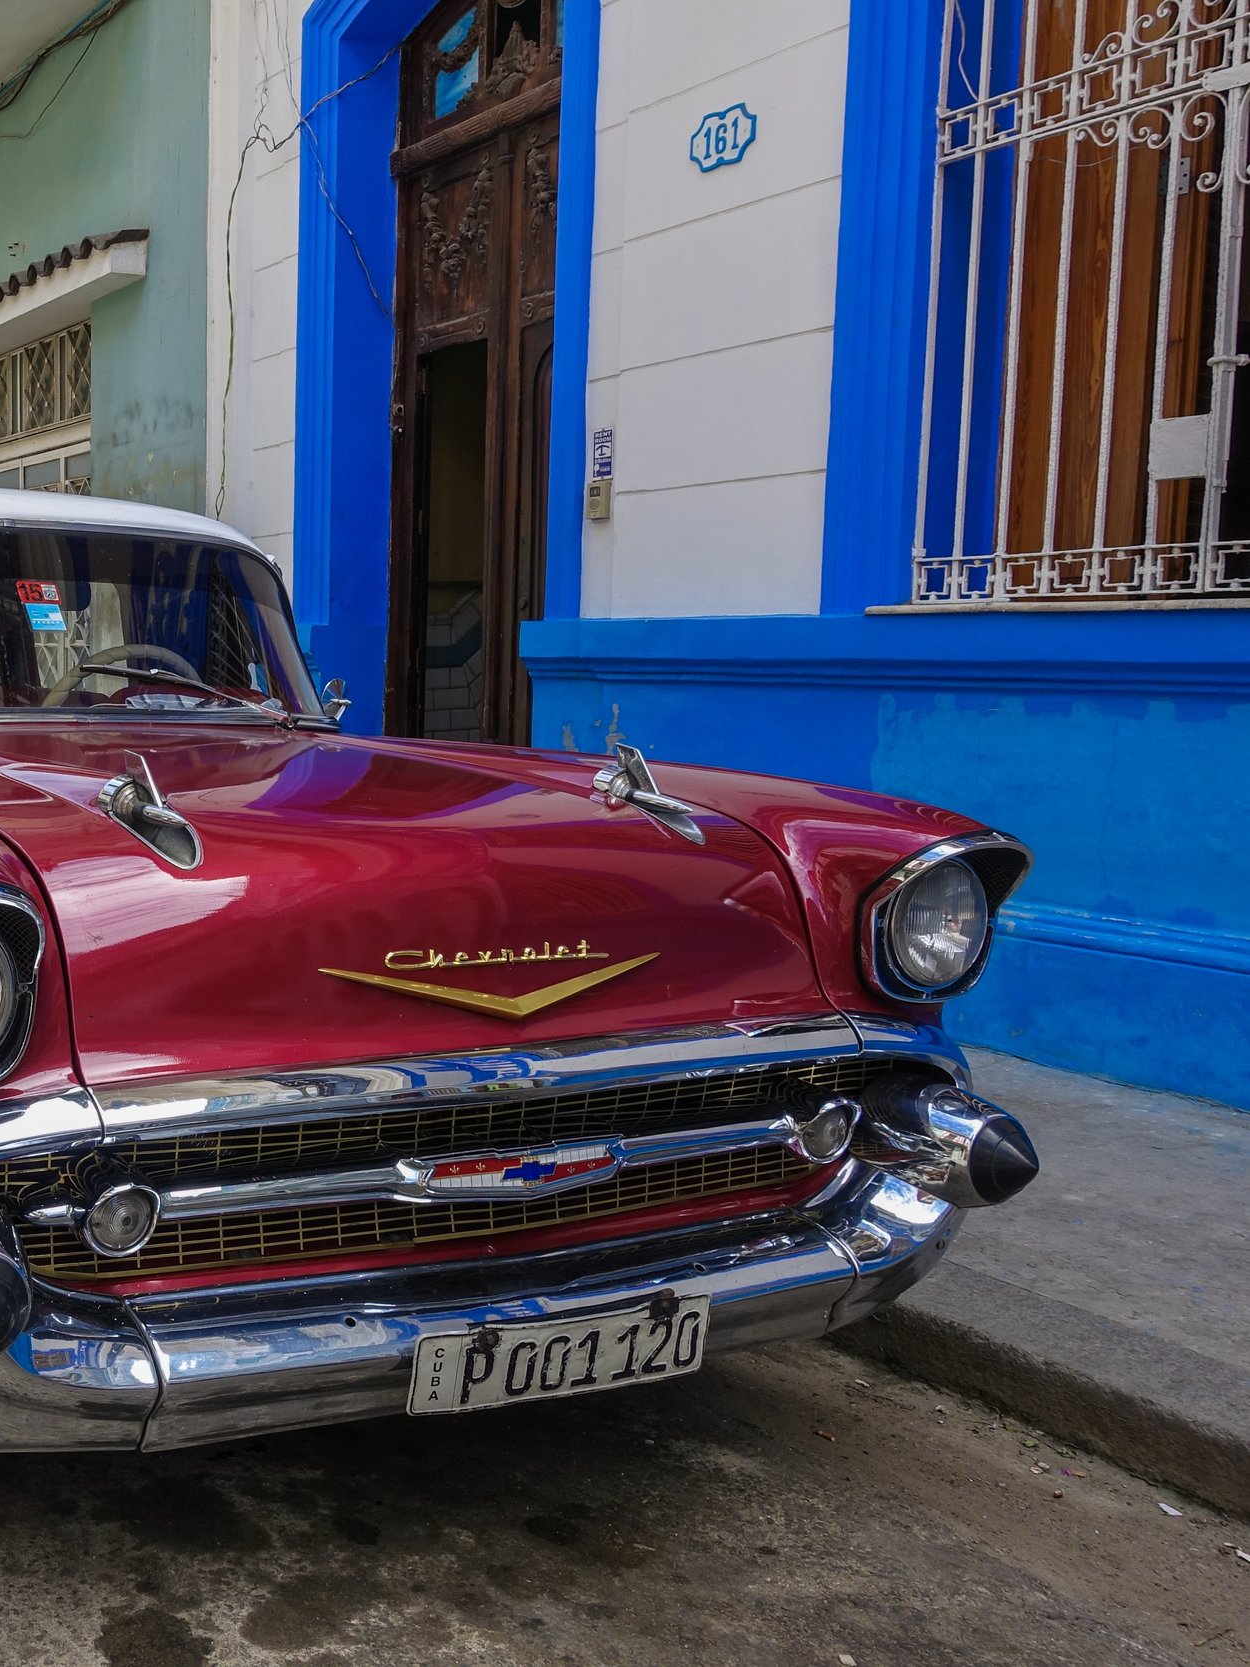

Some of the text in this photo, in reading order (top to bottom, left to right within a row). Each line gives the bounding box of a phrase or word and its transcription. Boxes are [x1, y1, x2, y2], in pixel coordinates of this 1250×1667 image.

[703, 117, 739, 160] 161
[18, 583, 44, 601] 15
[385, 939, 609, 969] Chevrolet
[428, 1347, 446, 1401] CUBA
